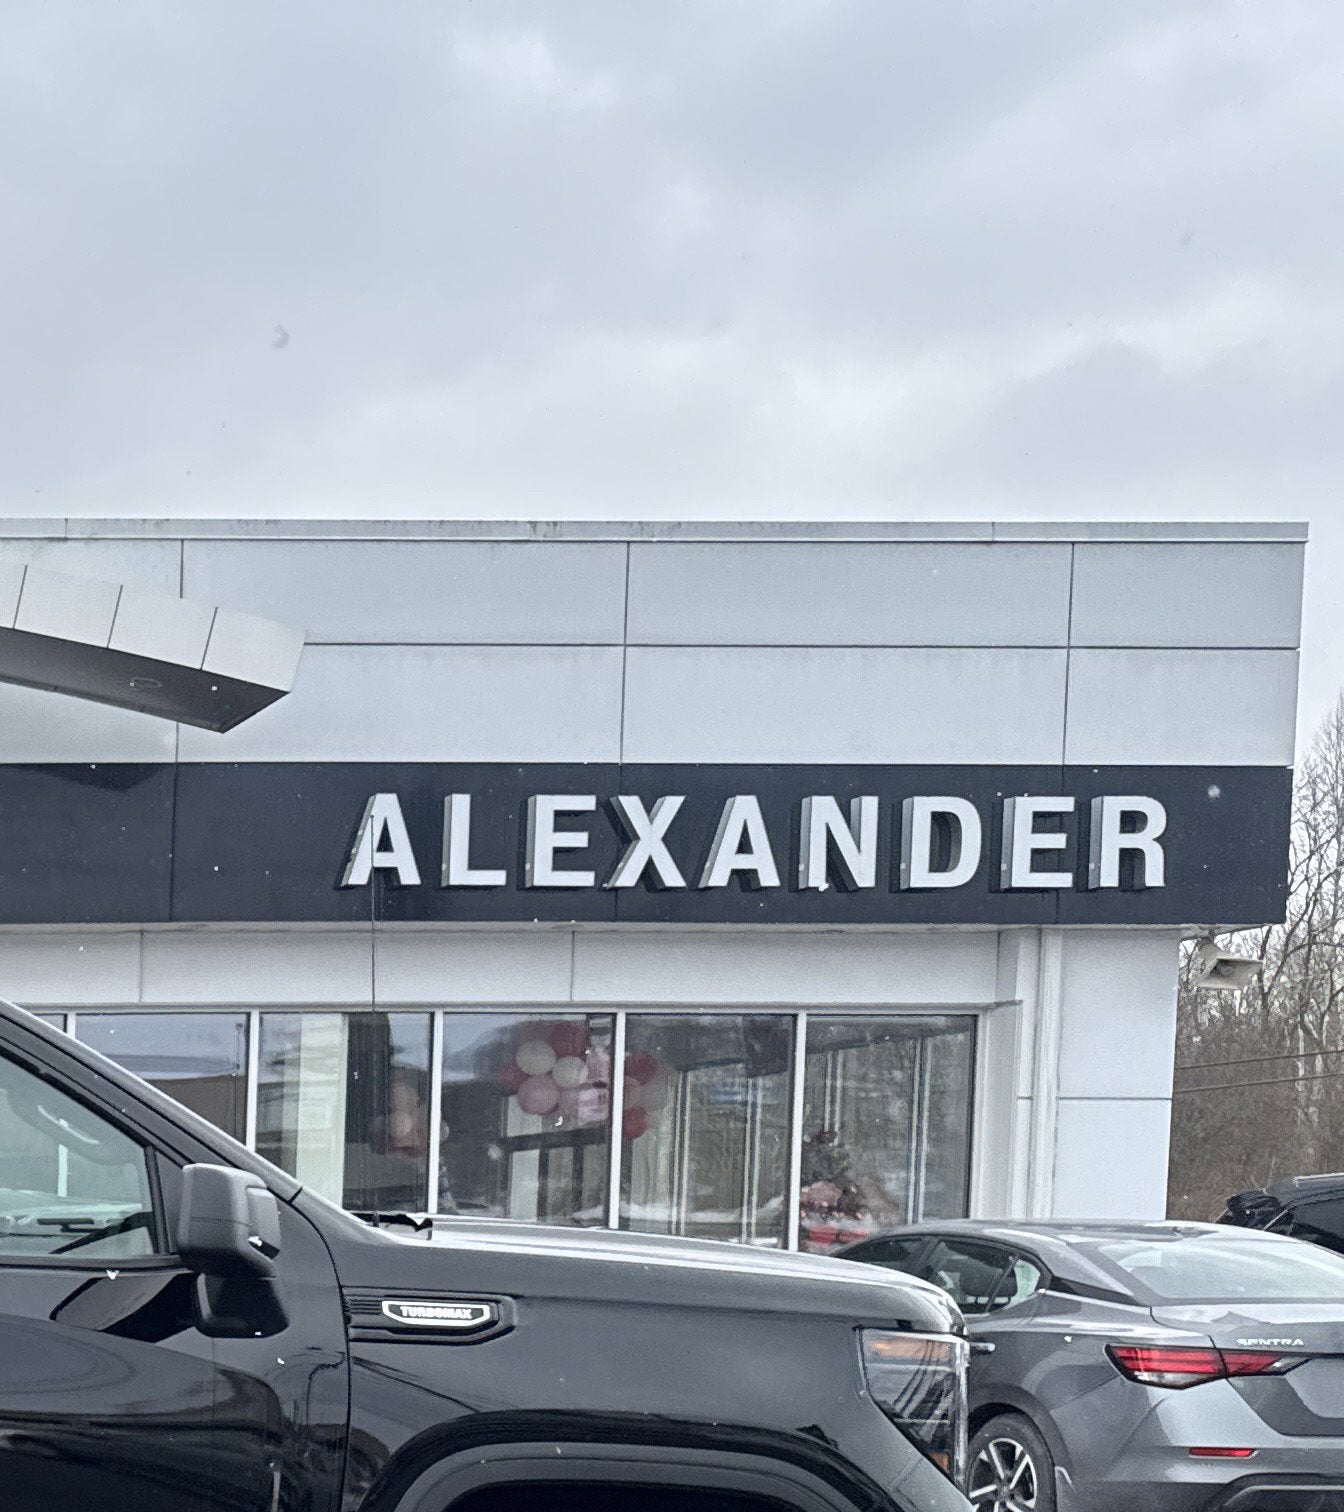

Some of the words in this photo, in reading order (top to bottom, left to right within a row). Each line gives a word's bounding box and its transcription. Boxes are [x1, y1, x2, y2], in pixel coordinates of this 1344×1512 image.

[341, 793, 1168, 888] ALEXANDER
[399, 1306, 473, 1320] TURBOMAX
[1236, 1338, 1305, 1347] SENTRA
